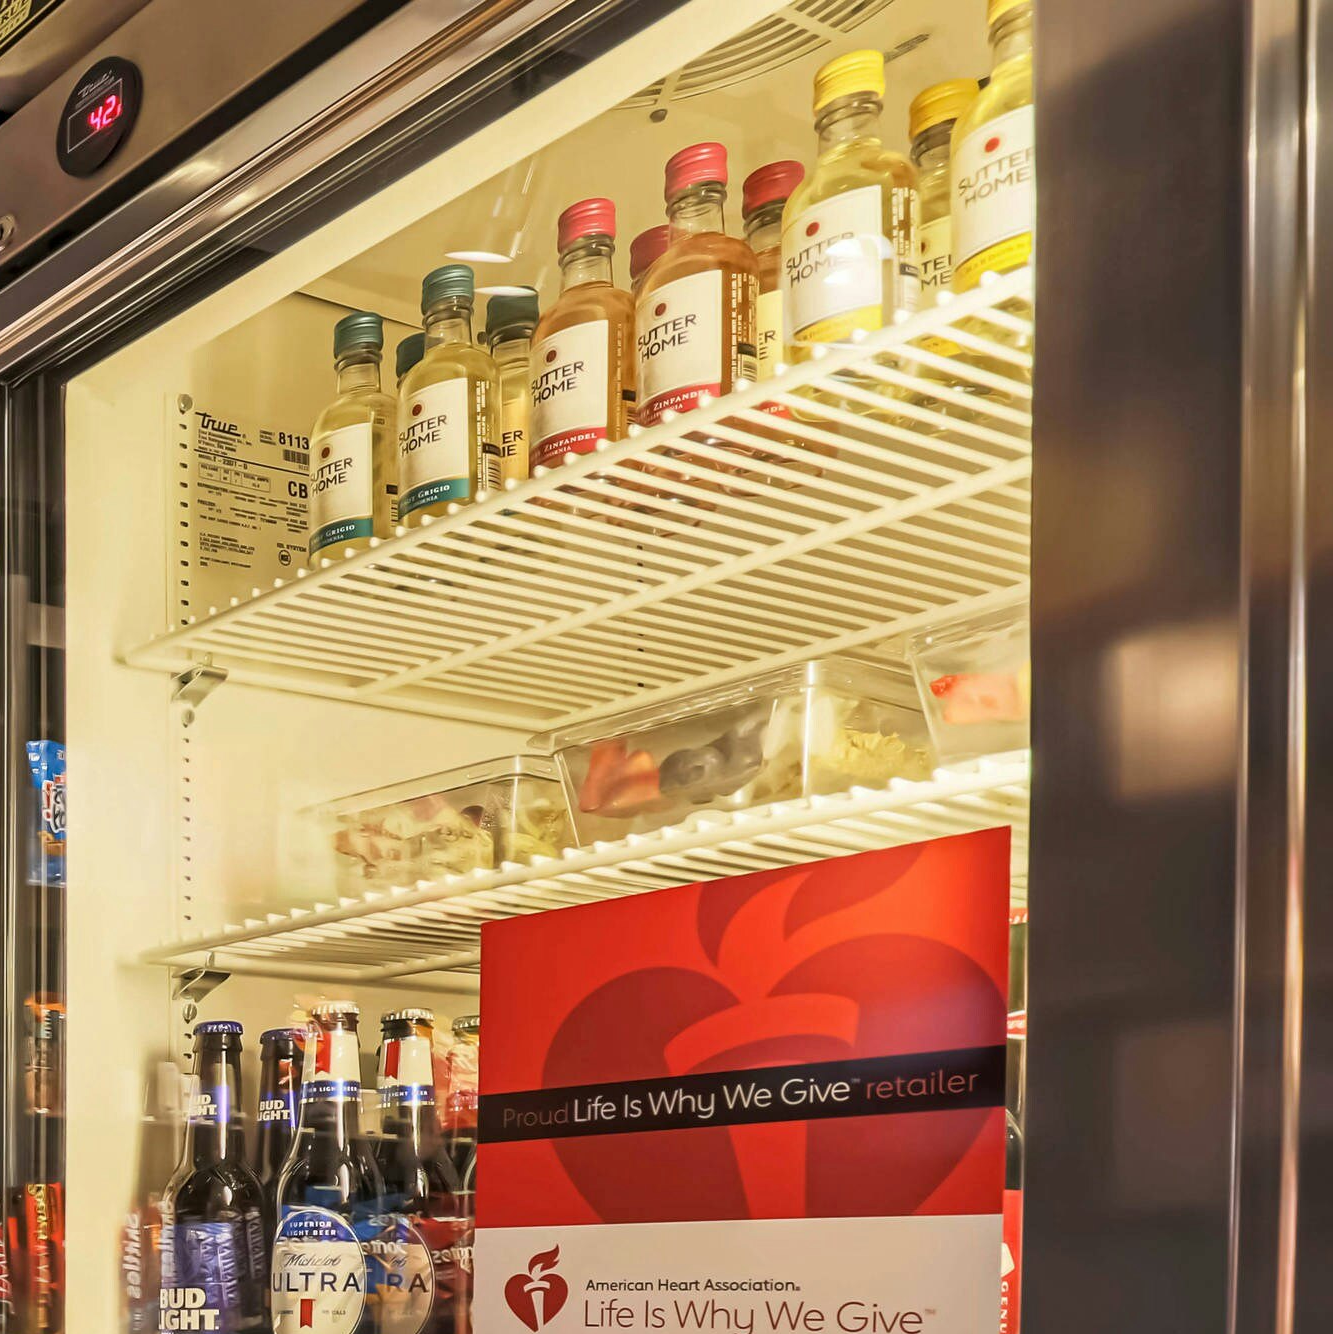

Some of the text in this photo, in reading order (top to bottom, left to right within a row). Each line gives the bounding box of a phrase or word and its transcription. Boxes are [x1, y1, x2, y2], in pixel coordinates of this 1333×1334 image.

[89, 95, 118, 130] 42
[964, 169, 1031, 209] HOME
[638, 313, 696, 352] SUTTER
[641, 331, 690, 364] HOME
[531, 360, 584, 396] SUTTER
[533, 376, 577, 407] HOME
[653, 388, 710, 411] ZINFANDEL
[398, 414, 447, 444] SUTTER
[401, 429, 442, 458] HOME
[544, 432, 597, 453] ZINFANDEL
[310, 457, 353, 484] SUTTER
[288, 480, 308, 499] CB
[312, 471, 348, 495] HOME
[417, 484, 451, 499] GRIGIO
[326, 524, 355, 537] GRIGIO
[503, 1069, 980, 1130] Proud Life Is Why We Give retailer
[289, 1220, 332, 1229] SUPERIOR
[312, 1229, 336, 1237] BEER
[283, 1252, 342, 1268] Michelob
[273, 1272, 361, 1293] ULTRA
[586, 1279, 654, 1293] American
[657, 1279, 701, 1293] Heart
[159, 1288, 206, 1309] BUD
[583, 1299, 635, 1329] Life
[644, 1300, 665, 1329] Is
[765, 1301, 826, 1332] We
[836, 1300, 925, 1334] Give
